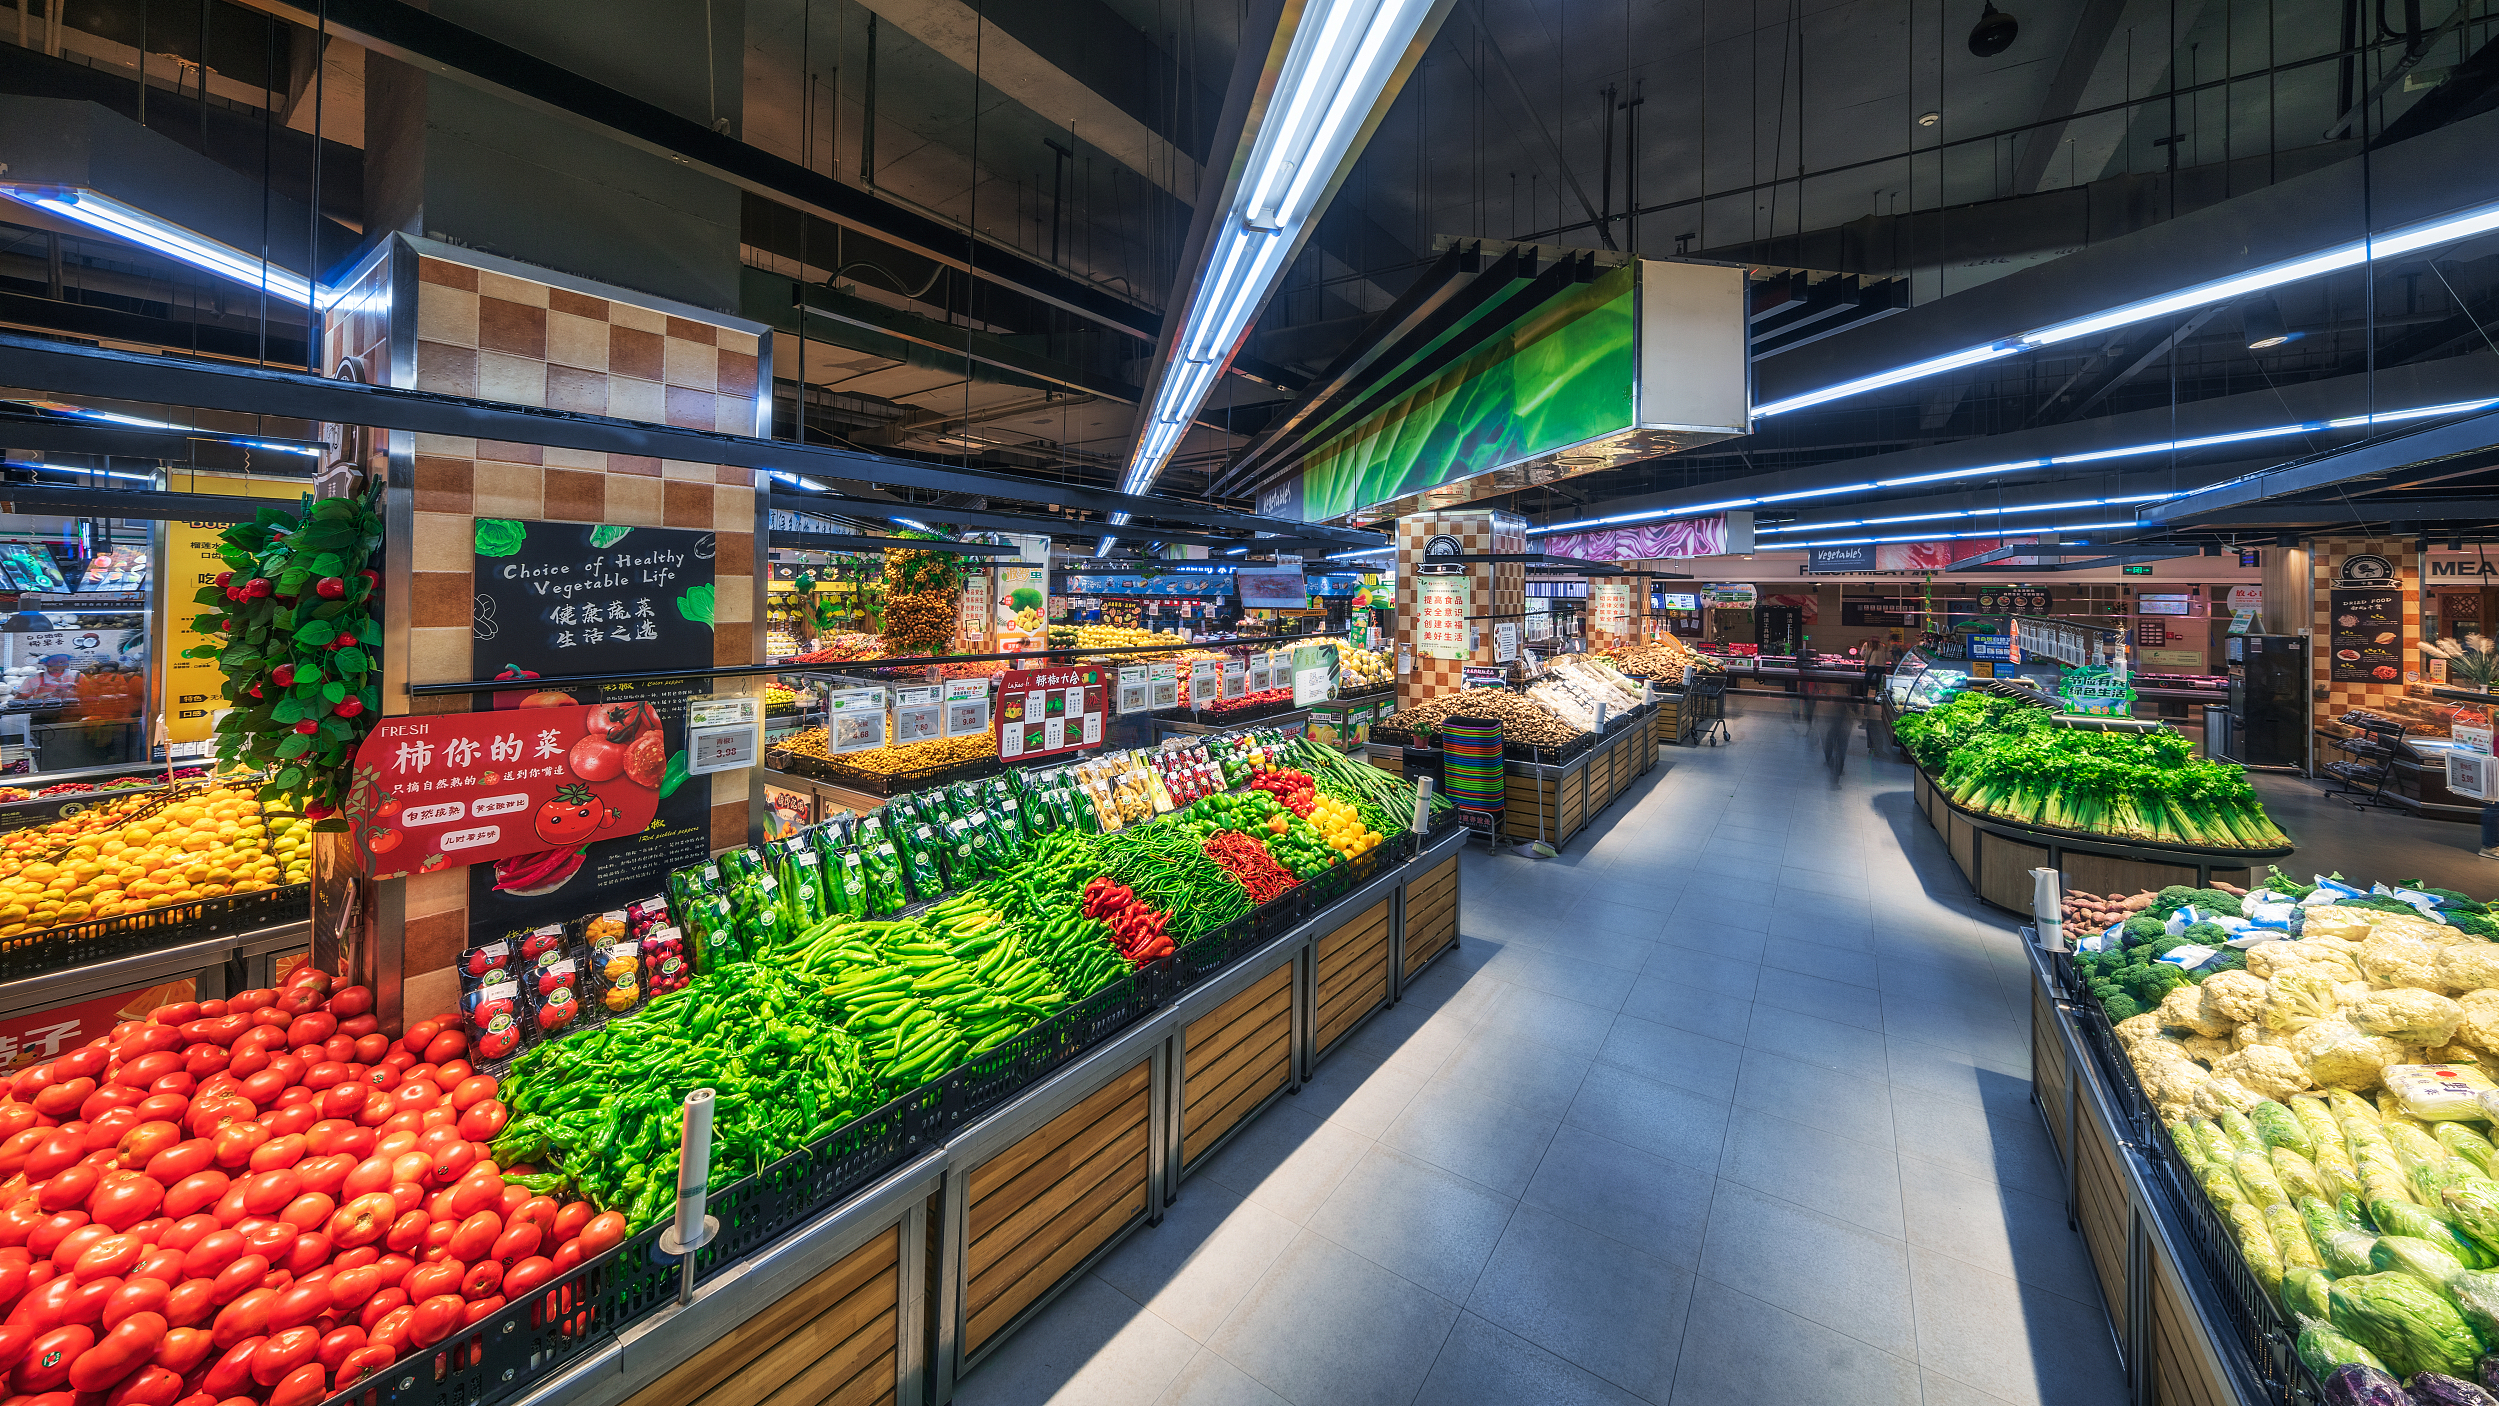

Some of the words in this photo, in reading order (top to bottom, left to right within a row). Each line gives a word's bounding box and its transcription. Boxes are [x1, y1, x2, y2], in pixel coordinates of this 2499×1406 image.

[1263, 481, 1291, 514] Vegetables
[191, 541, 224, 550] 榴莲水
[1818, 547, 1862, 561] Vegetables
[504, 564, 570, 579] Choice
[585, 556, 604, 577] of
[615, 550, 685, 568] Healthy
[2432, 561, 2499, 576] MEA
[534, 572, 629, 599] Vegetable
[643, 568, 676, 587] Life
[1423, 595, 1463, 605] 提高食品
[2235, 589, 2262, 597] 放心
[550, 597, 655, 625] 健康蔬菜
[1423, 607, 1463, 617] 安全意识
[1423, 619, 1463, 630] 创建幸福
[556, 619, 658, 648] 生活之选
[1423, 631, 1463, 642] 美好生活
[1036, 670, 1080, 688] 辣椒大会
[2069, 675, 2126, 687] 节俭有我
[2069, 687, 2126, 698] 绿色生活
[962, 717, 976, 726] 9.80
[381, 723, 429, 738] FRESH
[853, 730, 869, 740] 4.68
[391, 728, 566, 775] 柿你的菜
[716, 747, 737, 758] 3.98
[391, 775, 477, 796] 只摘自然熟的
[406, 805, 461, 822] 自然成熟
[475, 799, 525, 814] 黄金酸甜比
[644, 819, 666, 832] 椒
[444, 829, 497, 846] 儿时番茄味
